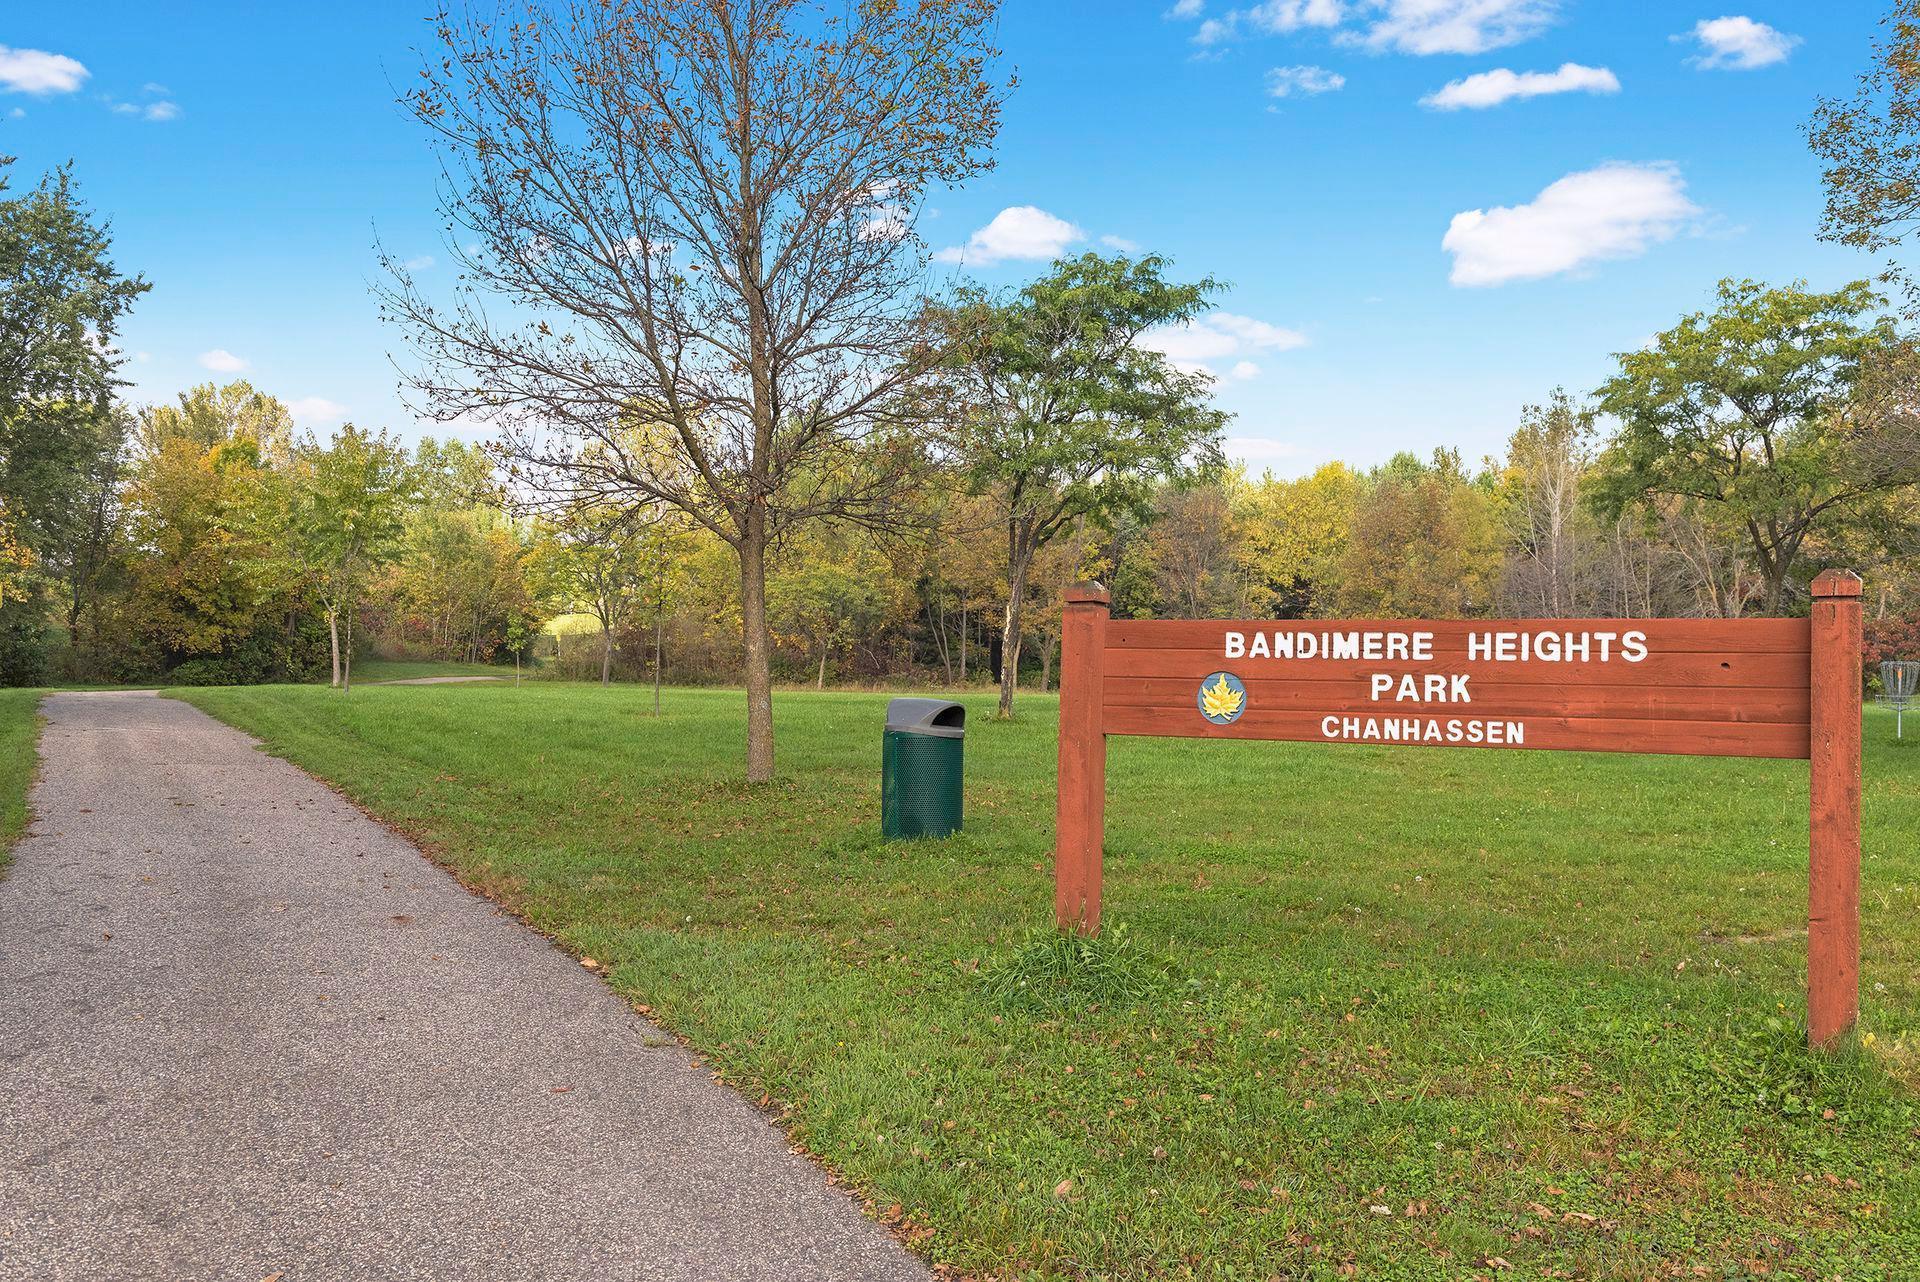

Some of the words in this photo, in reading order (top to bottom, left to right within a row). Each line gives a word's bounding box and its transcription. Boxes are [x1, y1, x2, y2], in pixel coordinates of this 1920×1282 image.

[1224, 631, 1434, 661] BANDIMERE
[1467, 630, 1649, 663] HEIGHTS
[1371, 673, 1471, 703] PARK
[1321, 715, 1524, 745] CHANHASSEN
